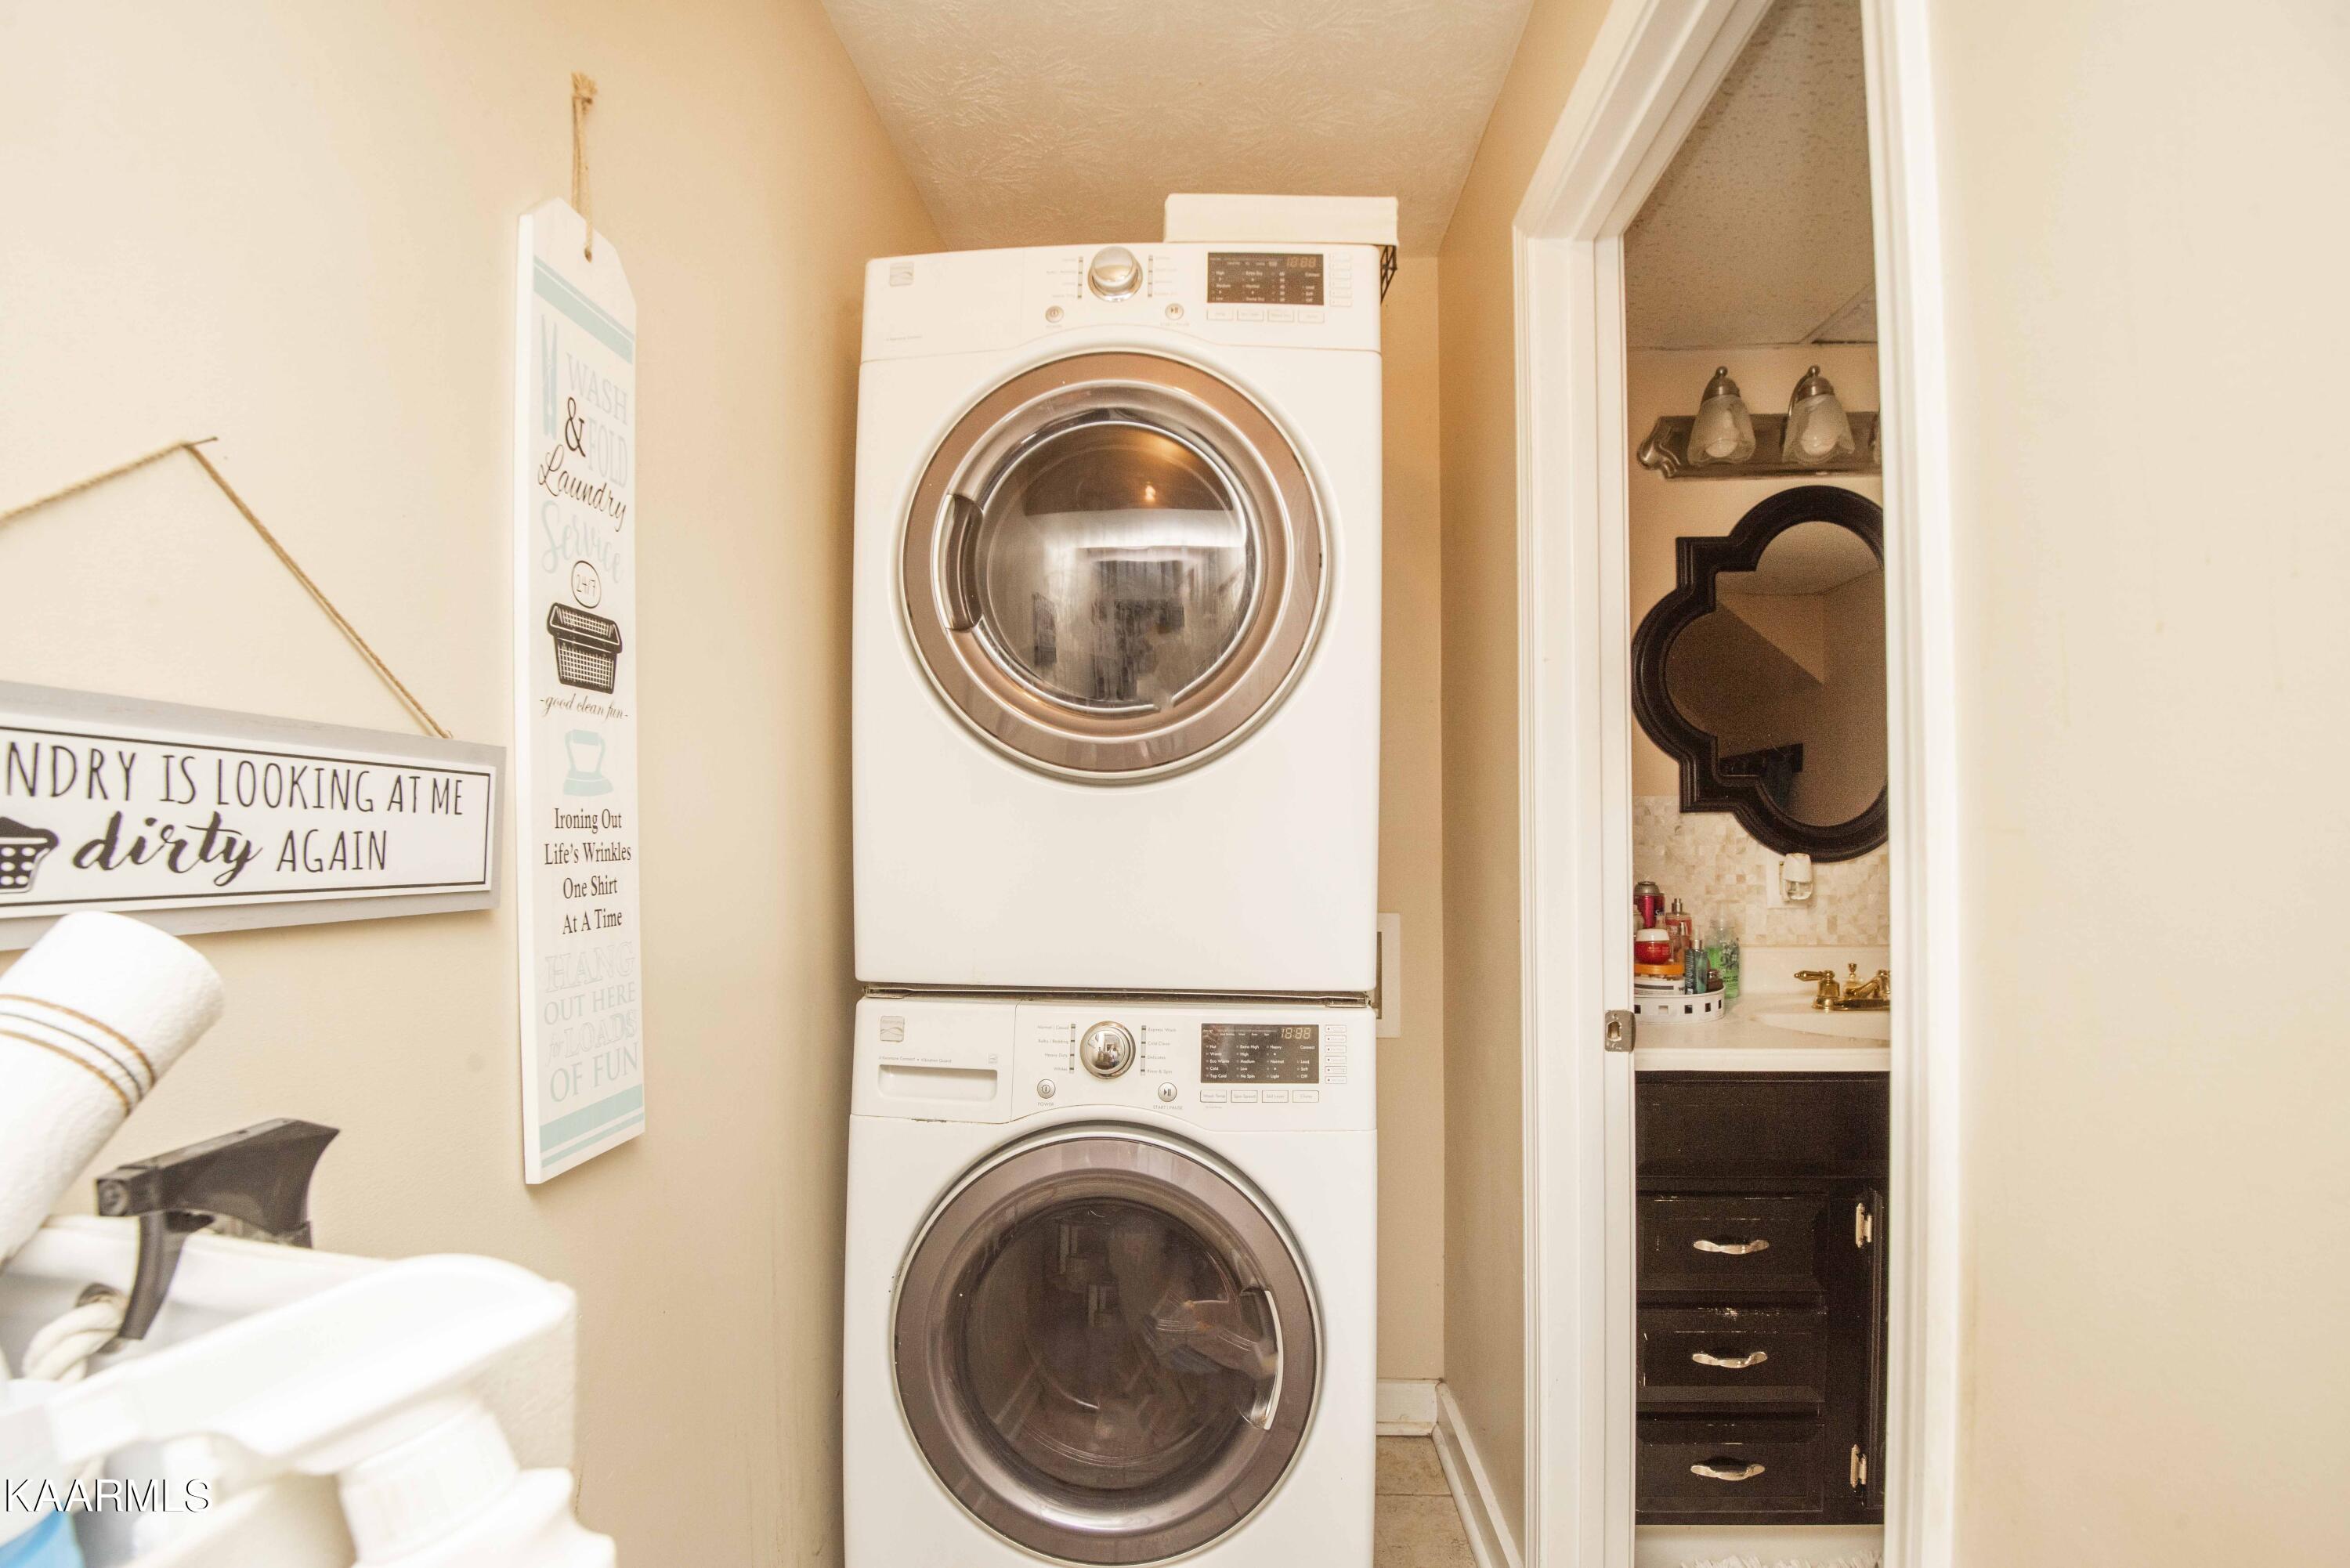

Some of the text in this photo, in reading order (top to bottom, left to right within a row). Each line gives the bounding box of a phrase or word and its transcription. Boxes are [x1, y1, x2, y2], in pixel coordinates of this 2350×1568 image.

[566, 352, 627, 425] WASH
[565, 396, 586, 457] &
[588, 417, 627, 488] FOLD
[538, 444, 626, 532] Laundry
[541, 500, 620, 583] Service
[577, 695, 604, 715] clean
[160, 755, 197, 804] IS
[217, 759, 374, 812] LOOKING
[388, 774, 421, 814] AT
[432, 778, 463, 815] ME
[73, 810, 387, 887] dirty AGAIN
[555, 808, 622, 833] Ironing Out
[544, 842, 631, 865] Life's Wrinkles
[563, 875, 617, 899] One Shirt
[562, 908, 622, 934] At A Time
[545, 941, 636, 993] HANG
[544, 981, 635, 1025] OUT HERE
[564, 1009, 637, 1058] LOADS
[550, 1042, 638, 1103] OF FUN
